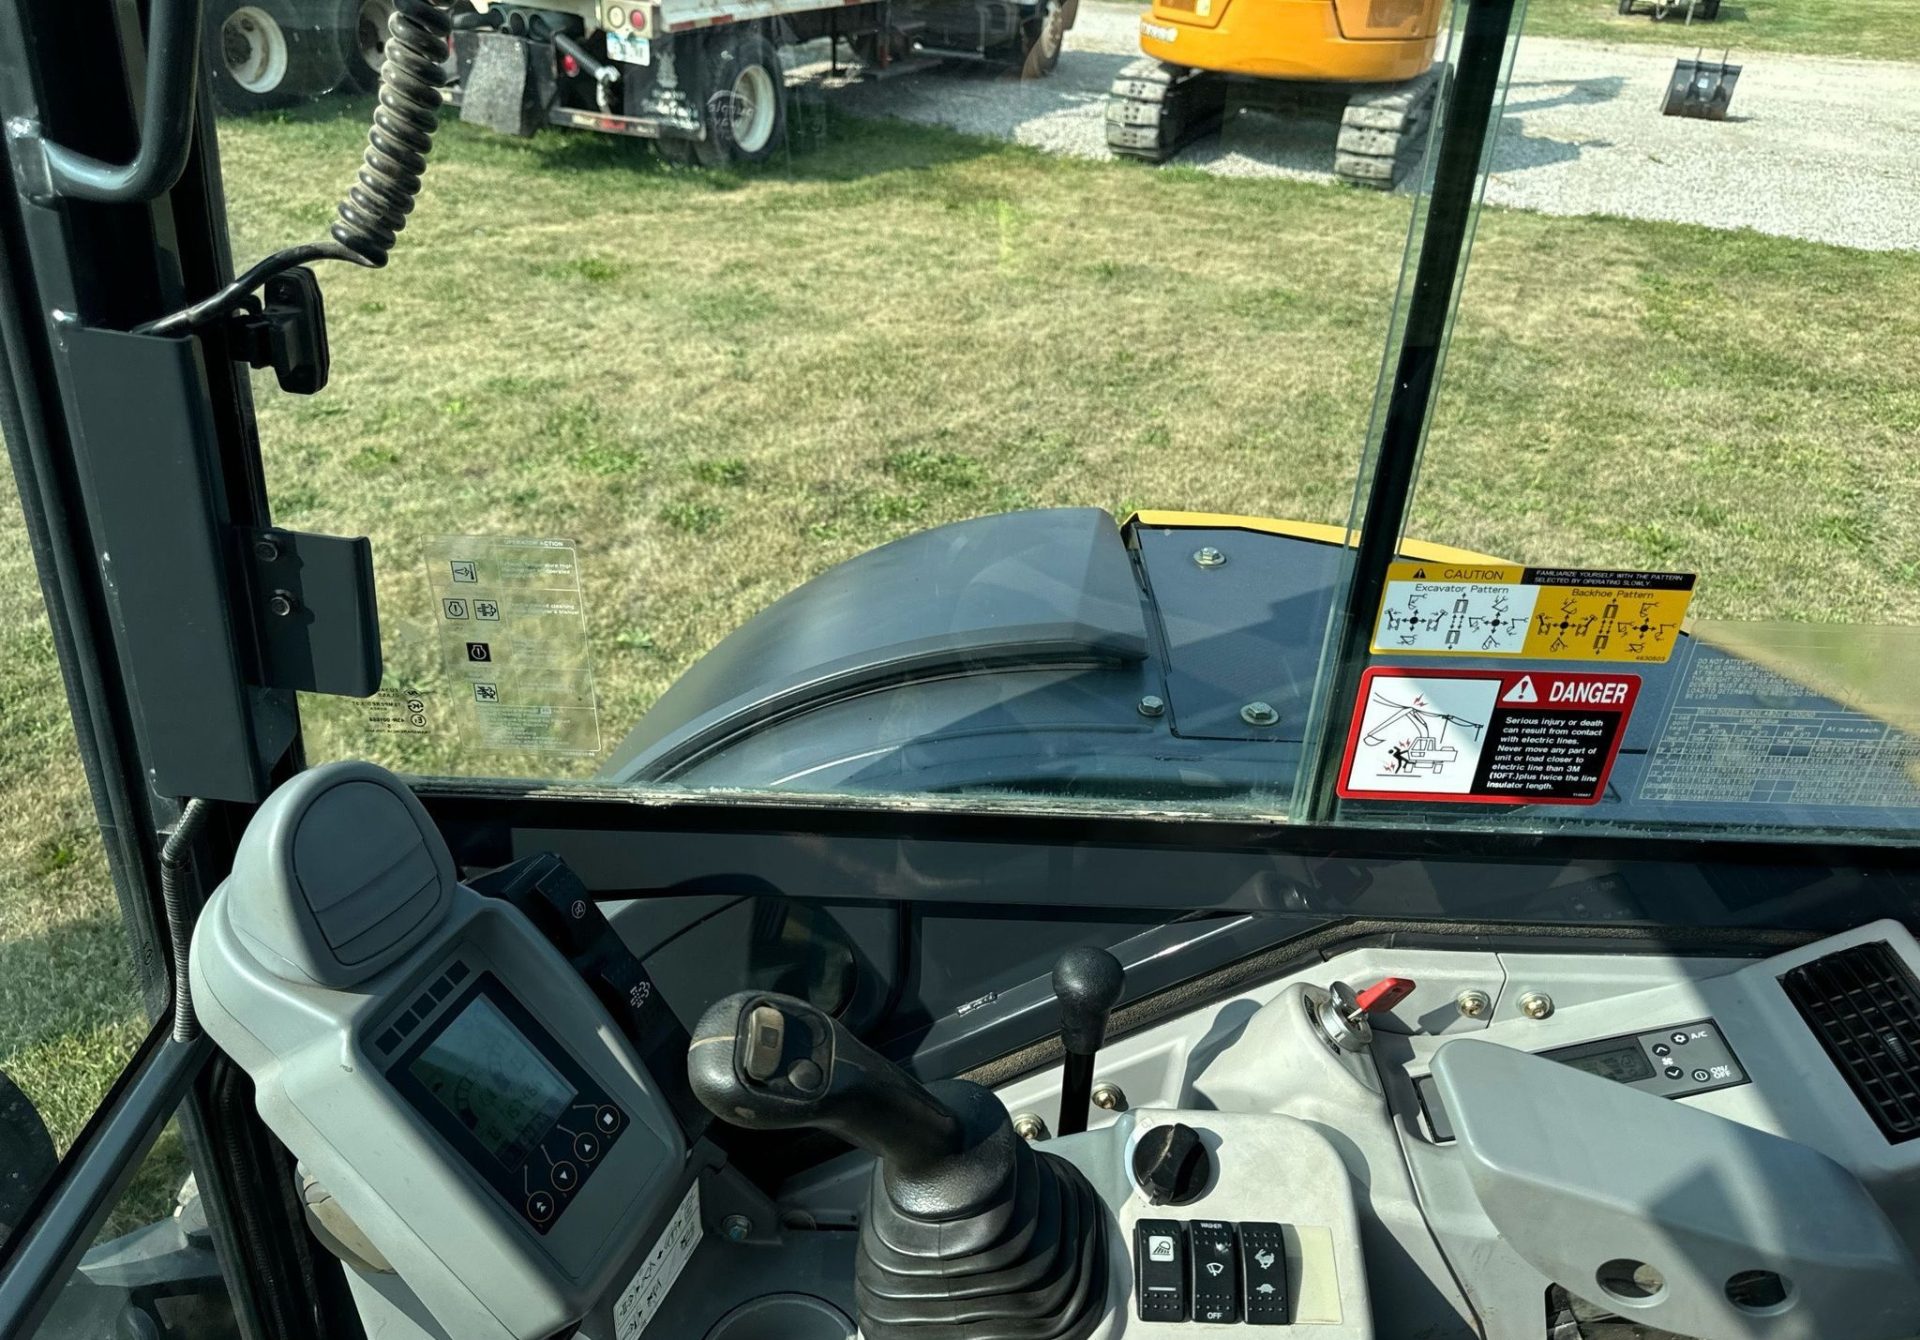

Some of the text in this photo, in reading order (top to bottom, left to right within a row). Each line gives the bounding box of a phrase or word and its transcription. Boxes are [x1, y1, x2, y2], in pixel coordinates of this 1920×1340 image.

[1444, 569, 1504, 580] CAUTION
[1415, 584, 1509, 594] Excavator Pattern
[1571, 588, 1654, 598] Backhoe Pattern
[1549, 681, 1629, 704] DANGER
[1505, 716, 1539, 725] Serious
[1541, 718, 1565, 727] injury
[1580, 719, 1604, 727] death
[1521, 736, 1554, 744] electric
[1556, 737, 1579, 745] lines.
[1526, 782, 1553, 790] length.
[1691, 1031, 1708, 1039] A/C
[1714, 1070, 1731, 1079] OFF
[1207, 1312, 1223, 1320] OFF
